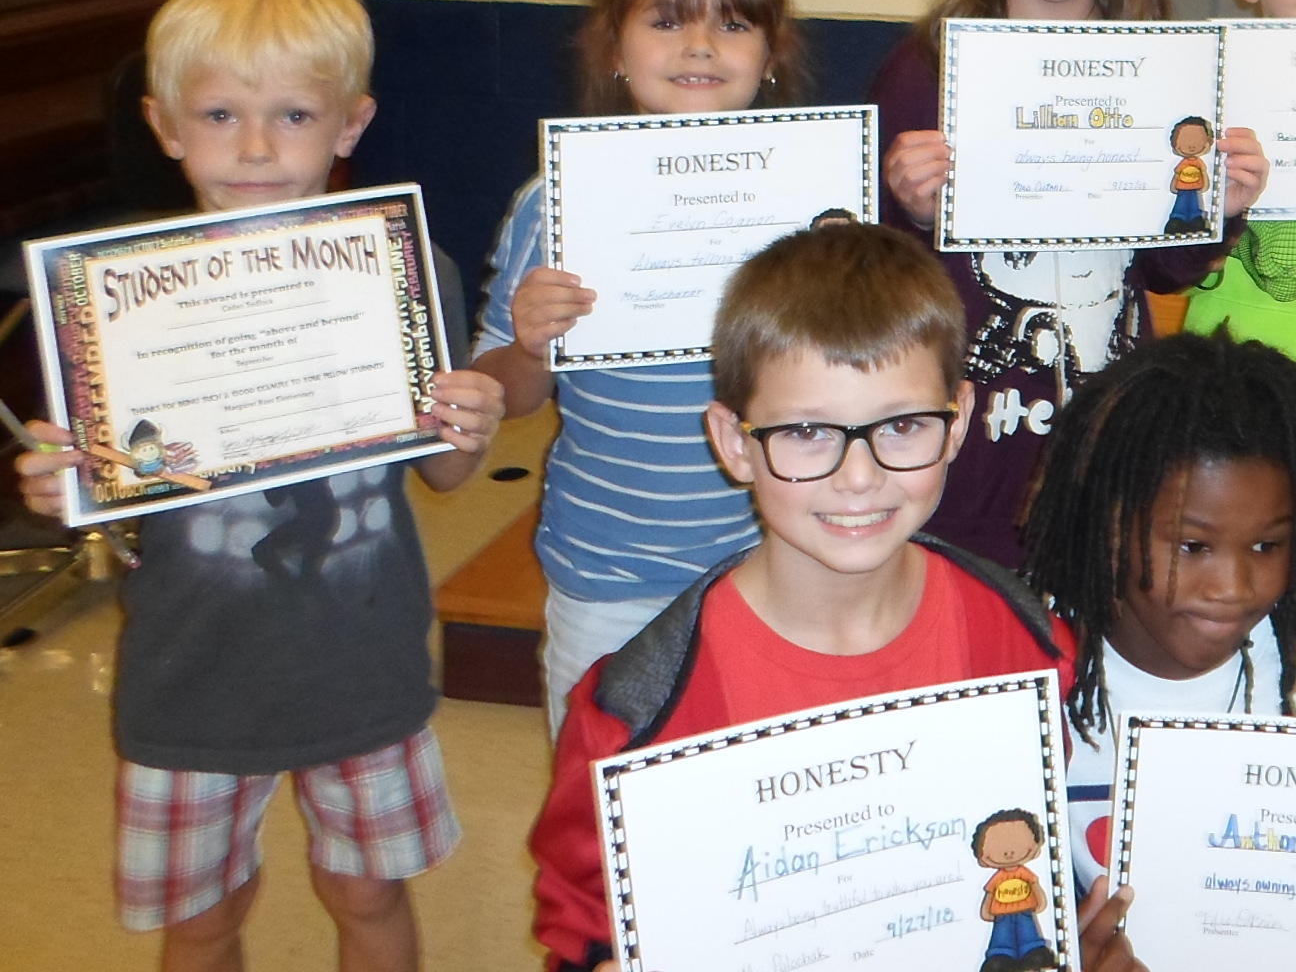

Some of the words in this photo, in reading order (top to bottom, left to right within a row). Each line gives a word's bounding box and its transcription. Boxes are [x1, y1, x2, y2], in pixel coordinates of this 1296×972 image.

[1042, 57, 1146, 78] HONESTY
[1055, 95, 1112, 107] Presented
[1115, 97, 1127, 107] to
[1015, 103, 1079, 129] Lillian
[1088, 106, 1135, 129] Otto
[656, 146, 775, 175] HONESTY
[673, 189, 740, 207] Presented
[742, 190, 756, 203] to
[709, 238, 722, 247] For
[104, 258, 199, 323] STUDENT
[207, 249, 233, 282] OF
[241, 244, 283, 274] THE
[292, 233, 381, 276] MONTH
[176, 298, 201, 310] This
[203, 292, 238, 304] award
[239, 291, 249, 300] is
[251, 281, 303, 298] presented
[304, 279, 316, 289] to
[151, 340, 213, 358] recognition
[215, 336, 226, 346] of
[228, 332, 258, 345] going
[299, 319, 320, 331] and
[210, 349, 227, 360] for
[228, 346, 247, 356] the
[249, 338, 285, 353] month
[757, 739, 918, 804] HONESTY
[784, 804, 872, 841] Presented
[877, 802, 897, 819] to
[737, 844, 820, 903] Aidan
[834, 815, 968, 862] Erickson
[837, 873, 854, 885] For
[1204, 872, 1251, 895] always
[1255, 878, 1296, 901] owning
[1202, 926, 1240, 938] Presenter
[852, 947, 876, 964] Date
